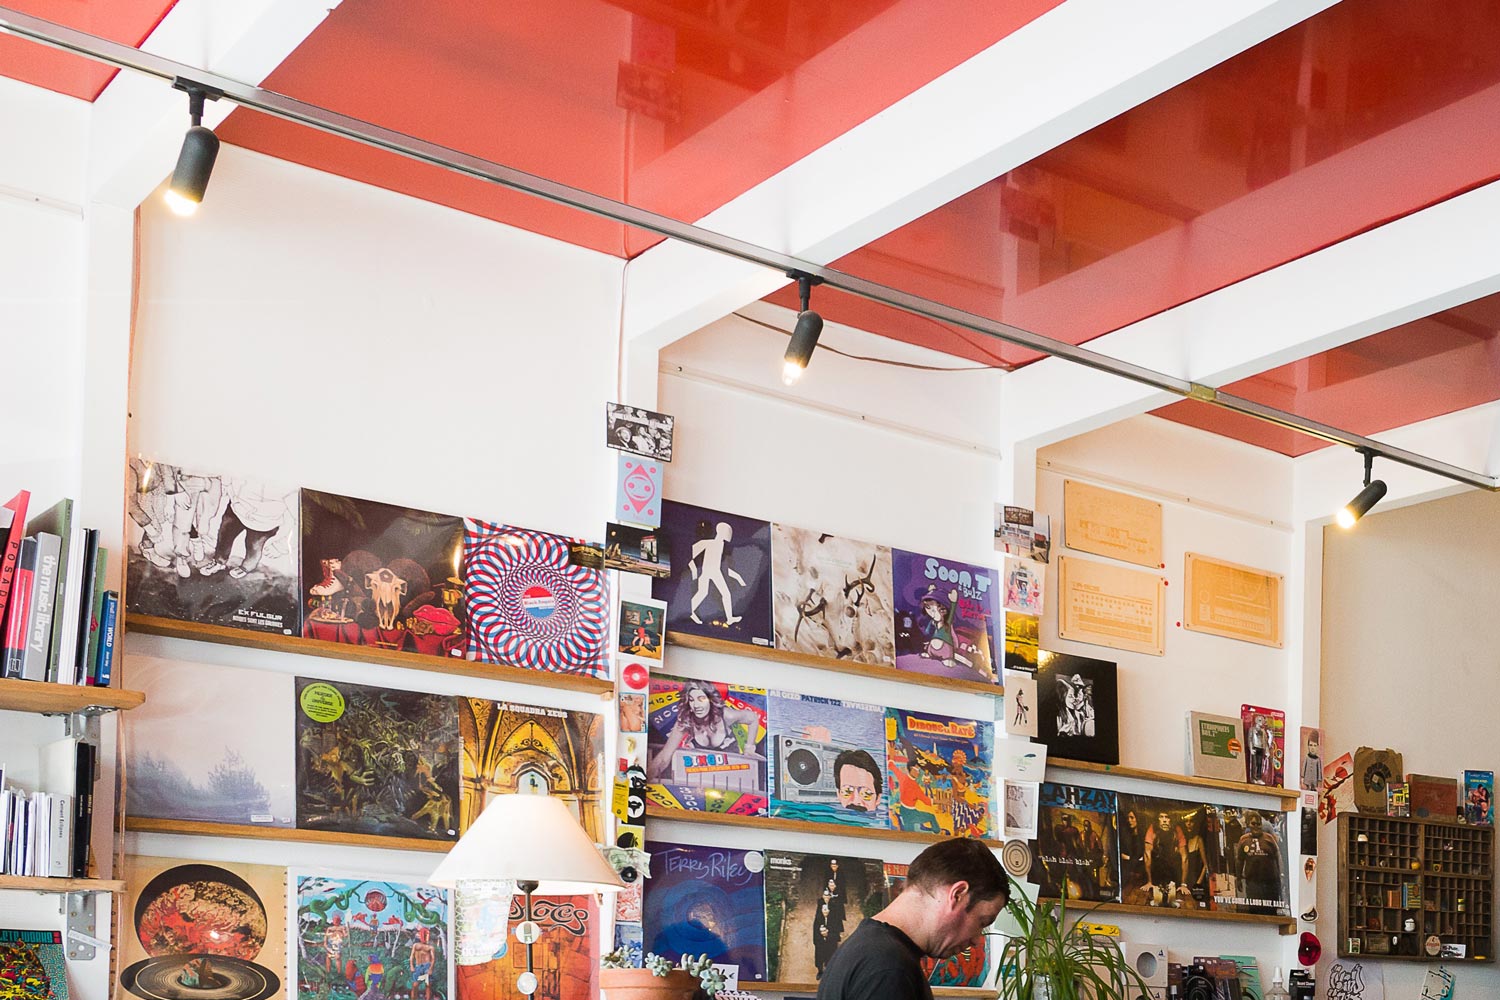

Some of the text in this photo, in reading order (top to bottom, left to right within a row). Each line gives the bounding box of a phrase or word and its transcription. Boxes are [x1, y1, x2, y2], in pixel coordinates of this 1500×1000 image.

[30, 555, 56, 652] the music library
[770, 857, 792, 866] monks
